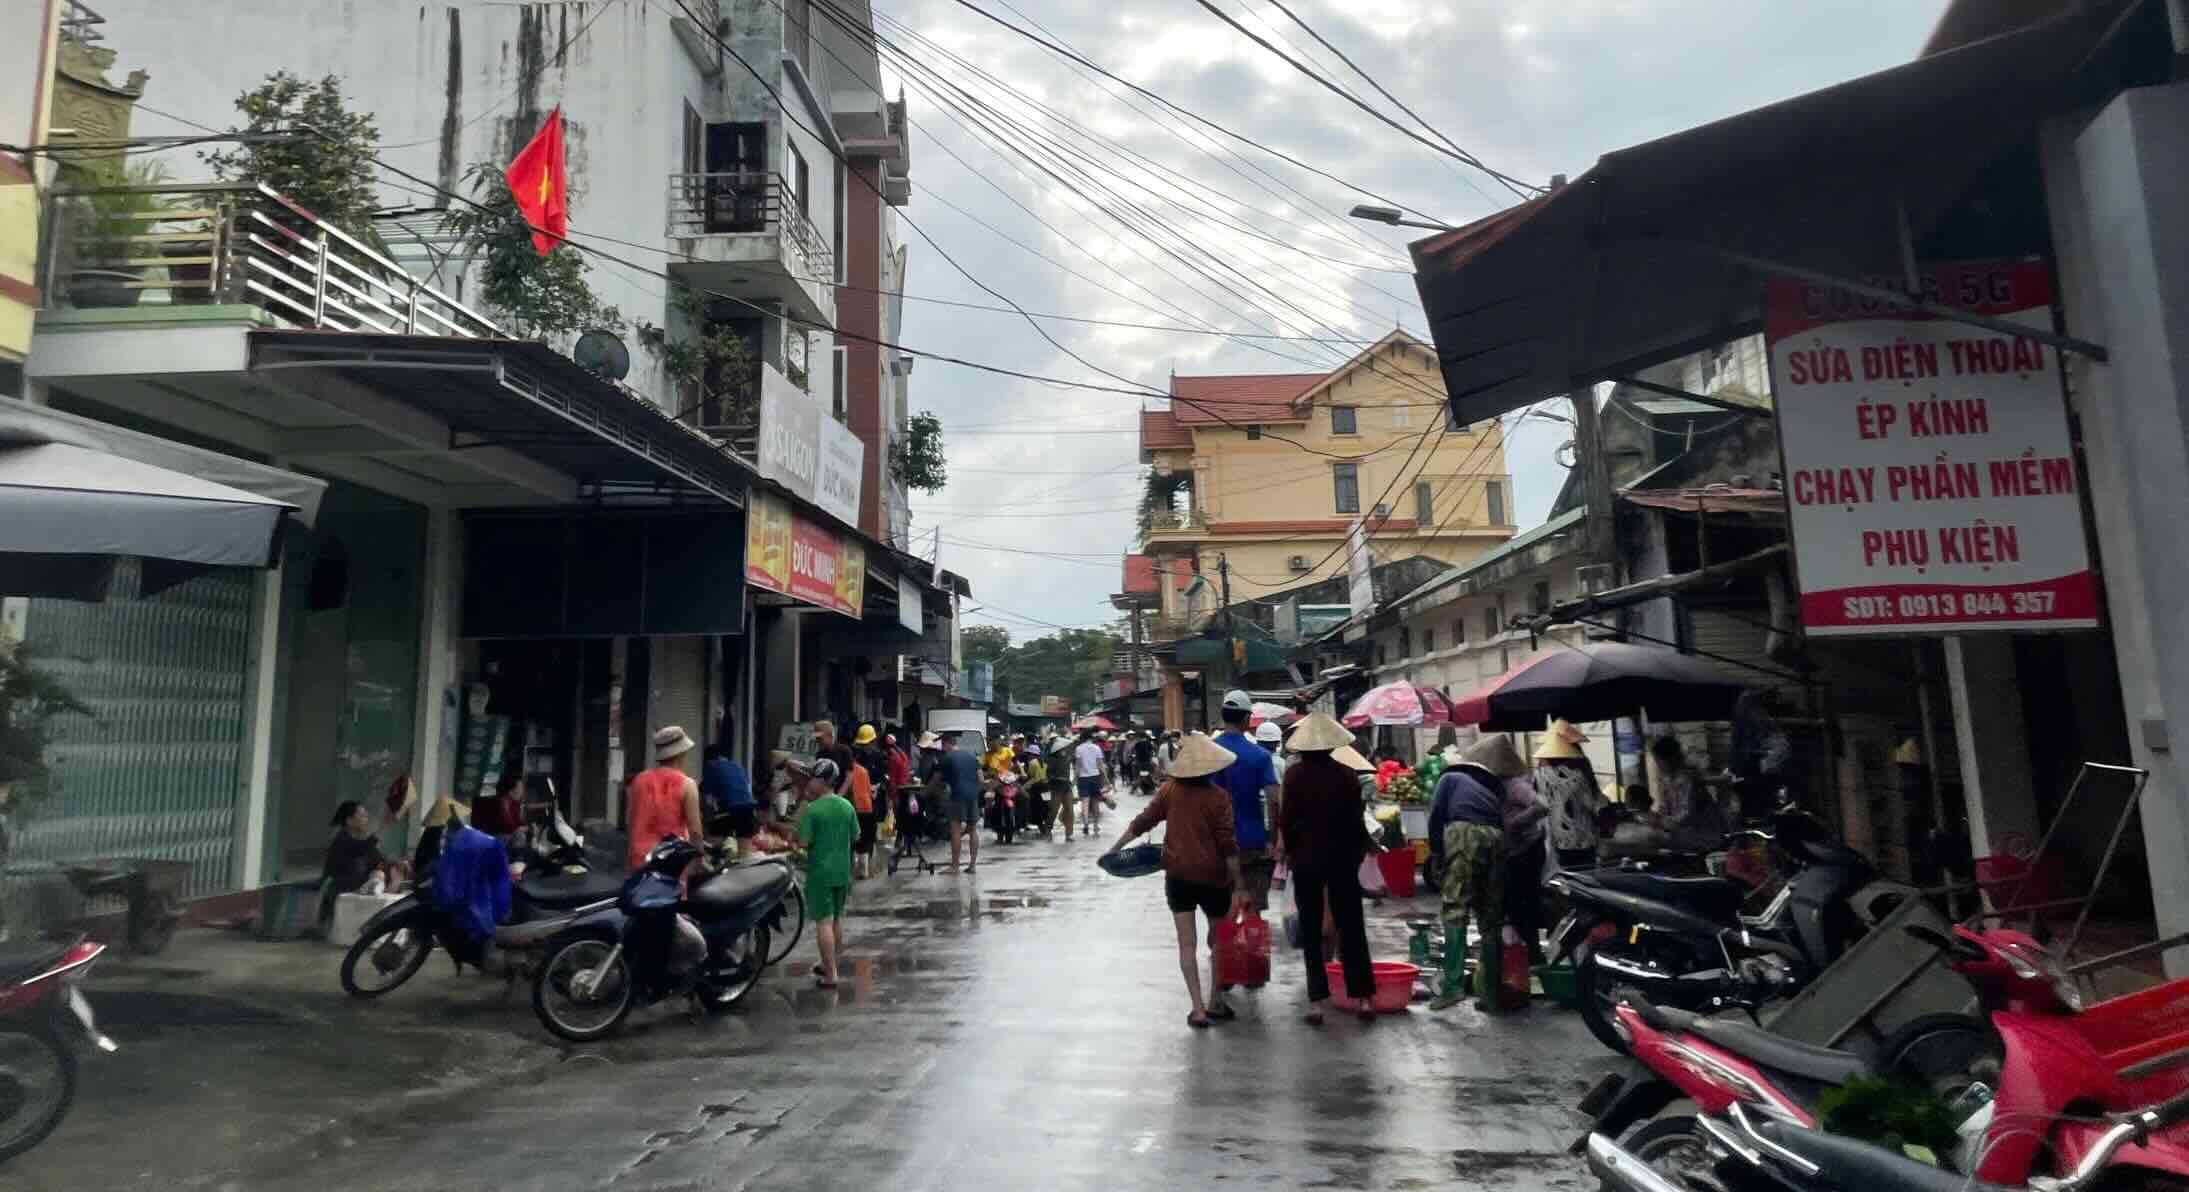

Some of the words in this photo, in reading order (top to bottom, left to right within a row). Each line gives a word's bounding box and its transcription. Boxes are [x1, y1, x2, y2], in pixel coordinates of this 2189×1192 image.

[1959, 270, 2013, 305] 5G
[1788, 338, 1853, 385] SỬA
[1862, 336, 1939, 387] ĐIỆN
[1949, 335, 2045, 381] THOẠI
[1856, 396, 1896, 440] ÉP
[1908, 391, 1989, 438] KÍNH
[1793, 466, 1875, 513] CHẠY
[1887, 450, 1981, 501] PHẦN
[1988, 446, 2074, 497] MỀM
[1862, 529, 1930, 575] PHỤ
[1939, 519, 2020, 572] KIỆN
[1844, 596, 1893, 619] SĐT:
[1899, 593, 1958, 617] 0913
[2012, 590, 2056, 614] 357
